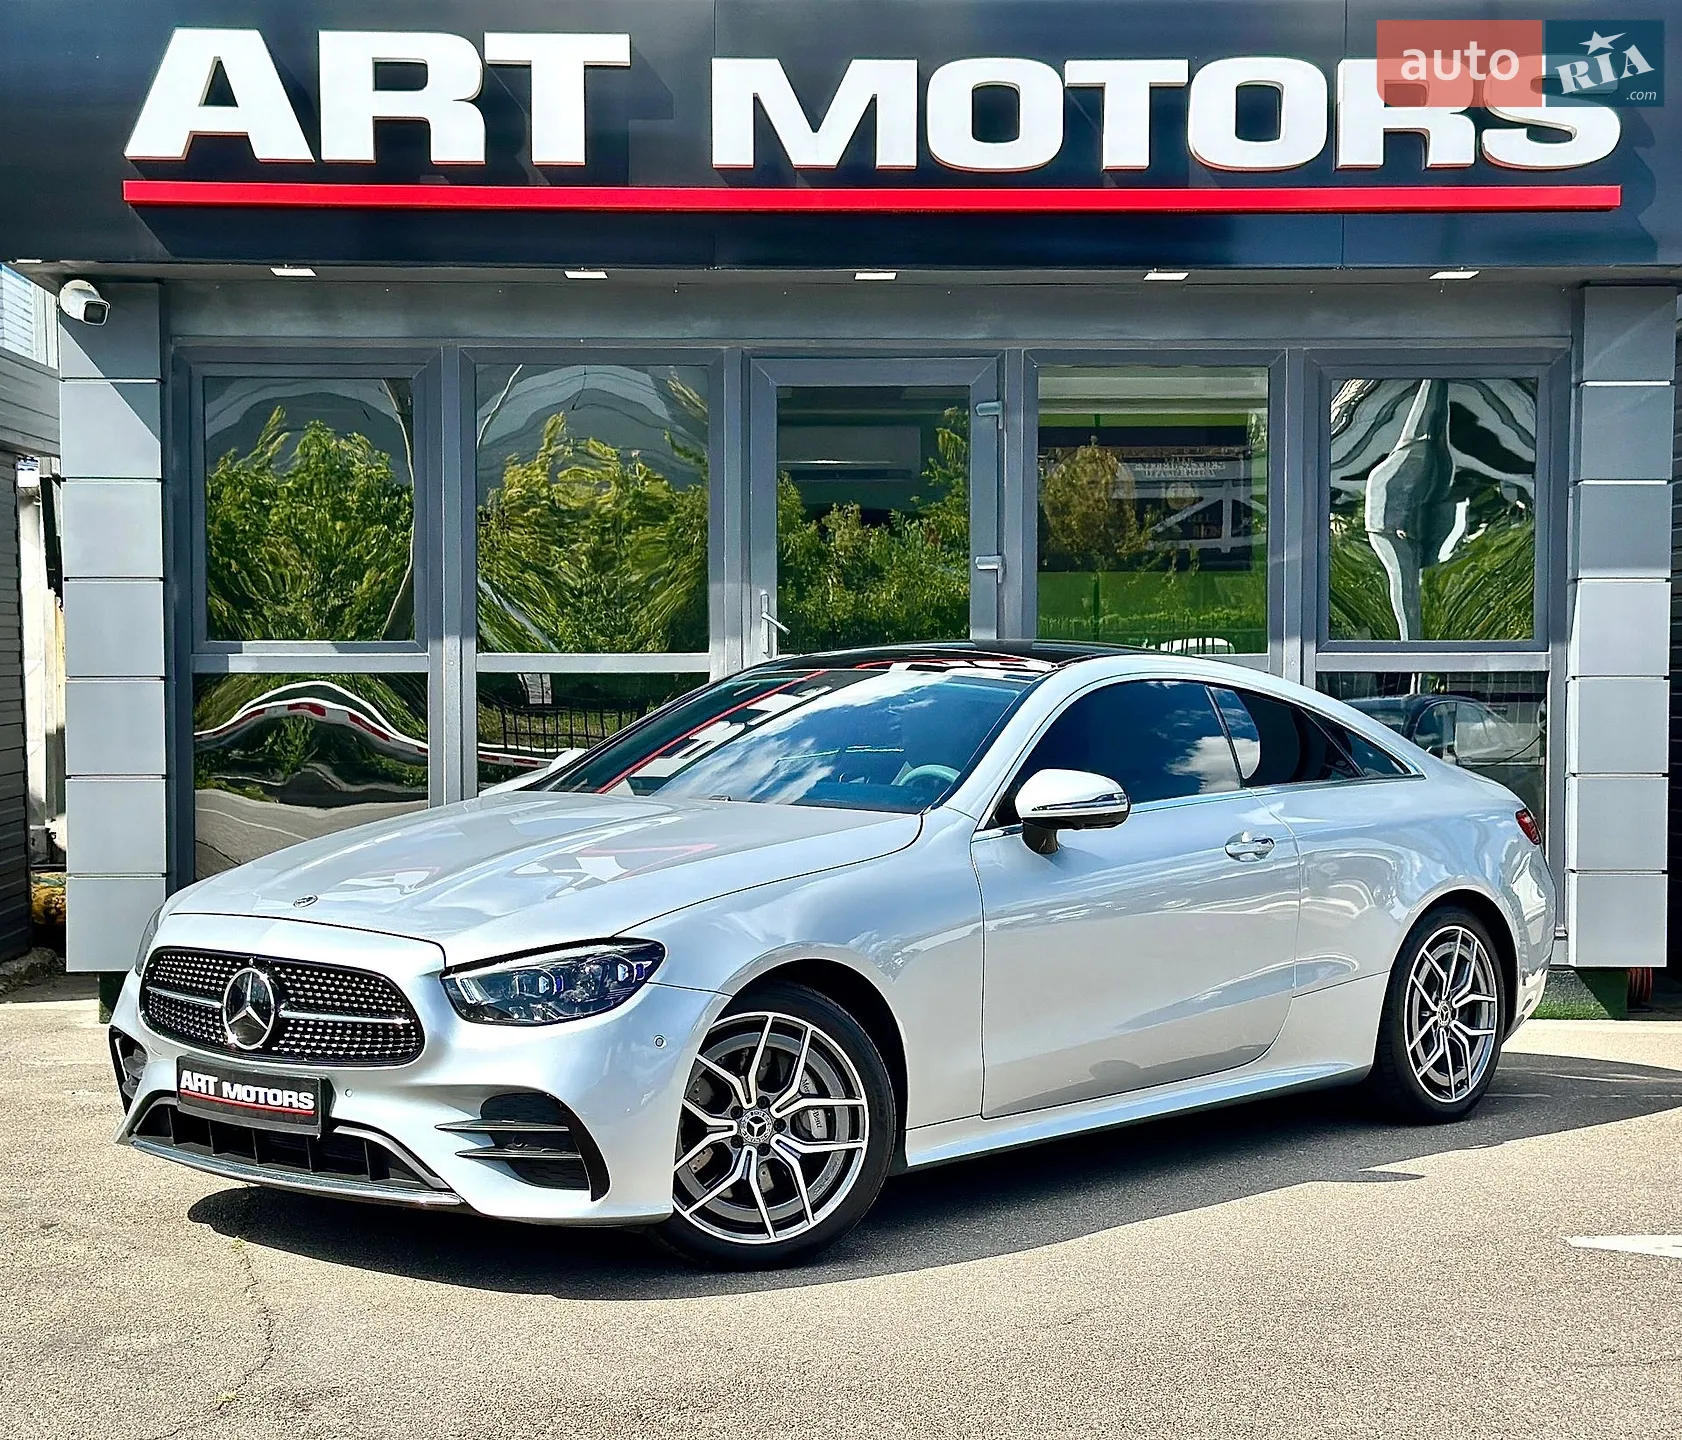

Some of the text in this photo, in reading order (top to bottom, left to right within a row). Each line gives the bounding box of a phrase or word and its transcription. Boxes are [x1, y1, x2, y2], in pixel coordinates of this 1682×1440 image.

[124, 27, 1621, 170] ART MOTORS
[180, 1069, 315, 1110] ART MOTORS
